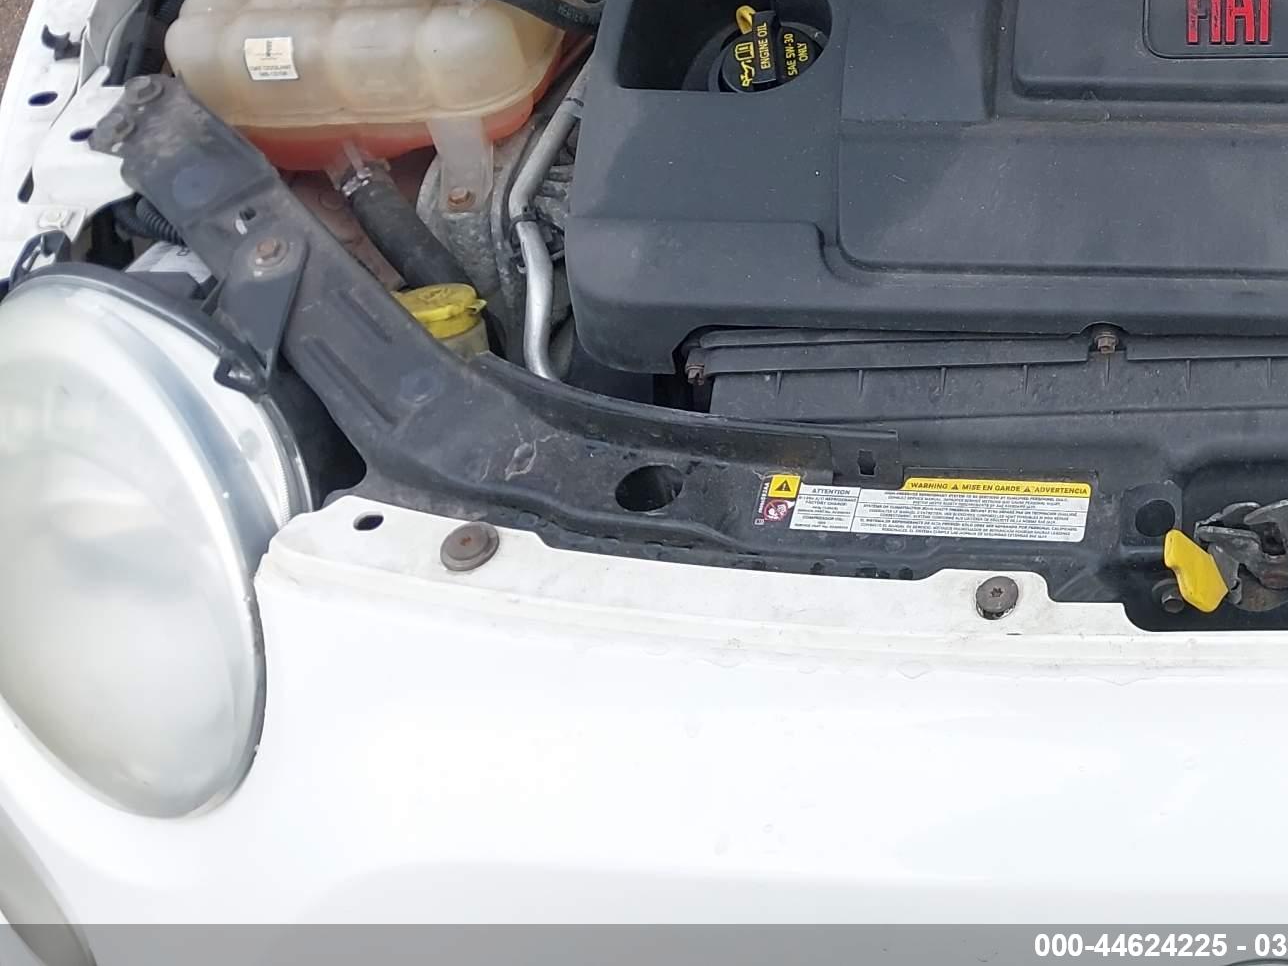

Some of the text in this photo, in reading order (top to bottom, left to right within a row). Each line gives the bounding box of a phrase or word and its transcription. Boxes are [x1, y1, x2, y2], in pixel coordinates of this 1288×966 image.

[757, 22, 771, 69] ENGINE OIL
[796, 42, 809, 62] ONLY
[787, 60, 799, 76] SAE
[910, 481, 948, 490] WARNING
[961, 483, 982, 491] MISE
[994, 484, 1021, 492] GARDE
[1034, 485, 1088, 495] ADVERTENCIA
